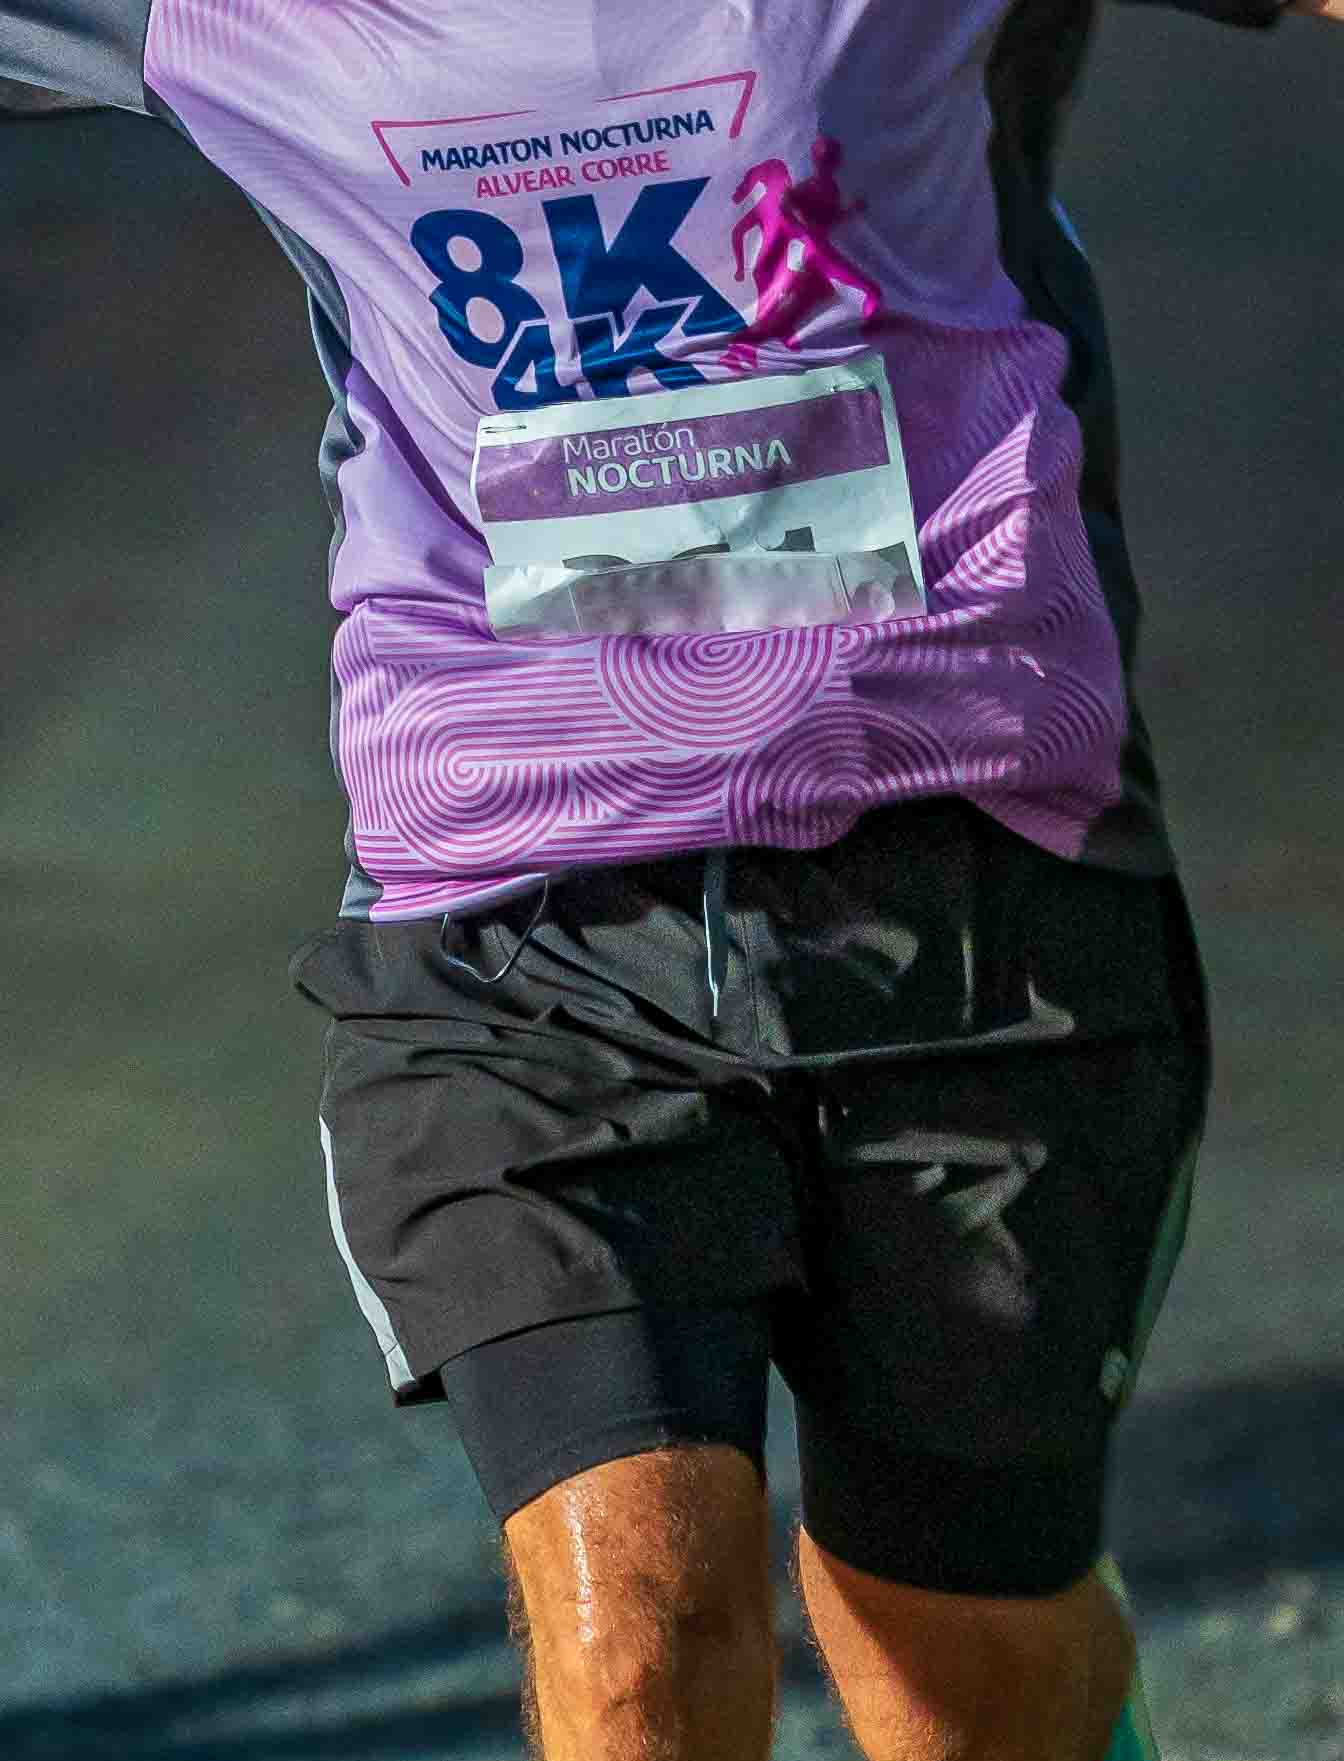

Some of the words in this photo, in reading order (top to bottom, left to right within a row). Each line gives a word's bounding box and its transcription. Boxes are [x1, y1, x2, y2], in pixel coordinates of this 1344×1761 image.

[421, 135, 553, 172] MARATON
[559, 109, 715, 155] NOCTURNA
[476, 166, 575, 199] ALVEAR
[581, 150, 671, 182] CORRE
[410, 176, 749, 369] 8K
[562, 422, 696, 465] Maratón
[566, 438, 792, 498] NOCTURNA
